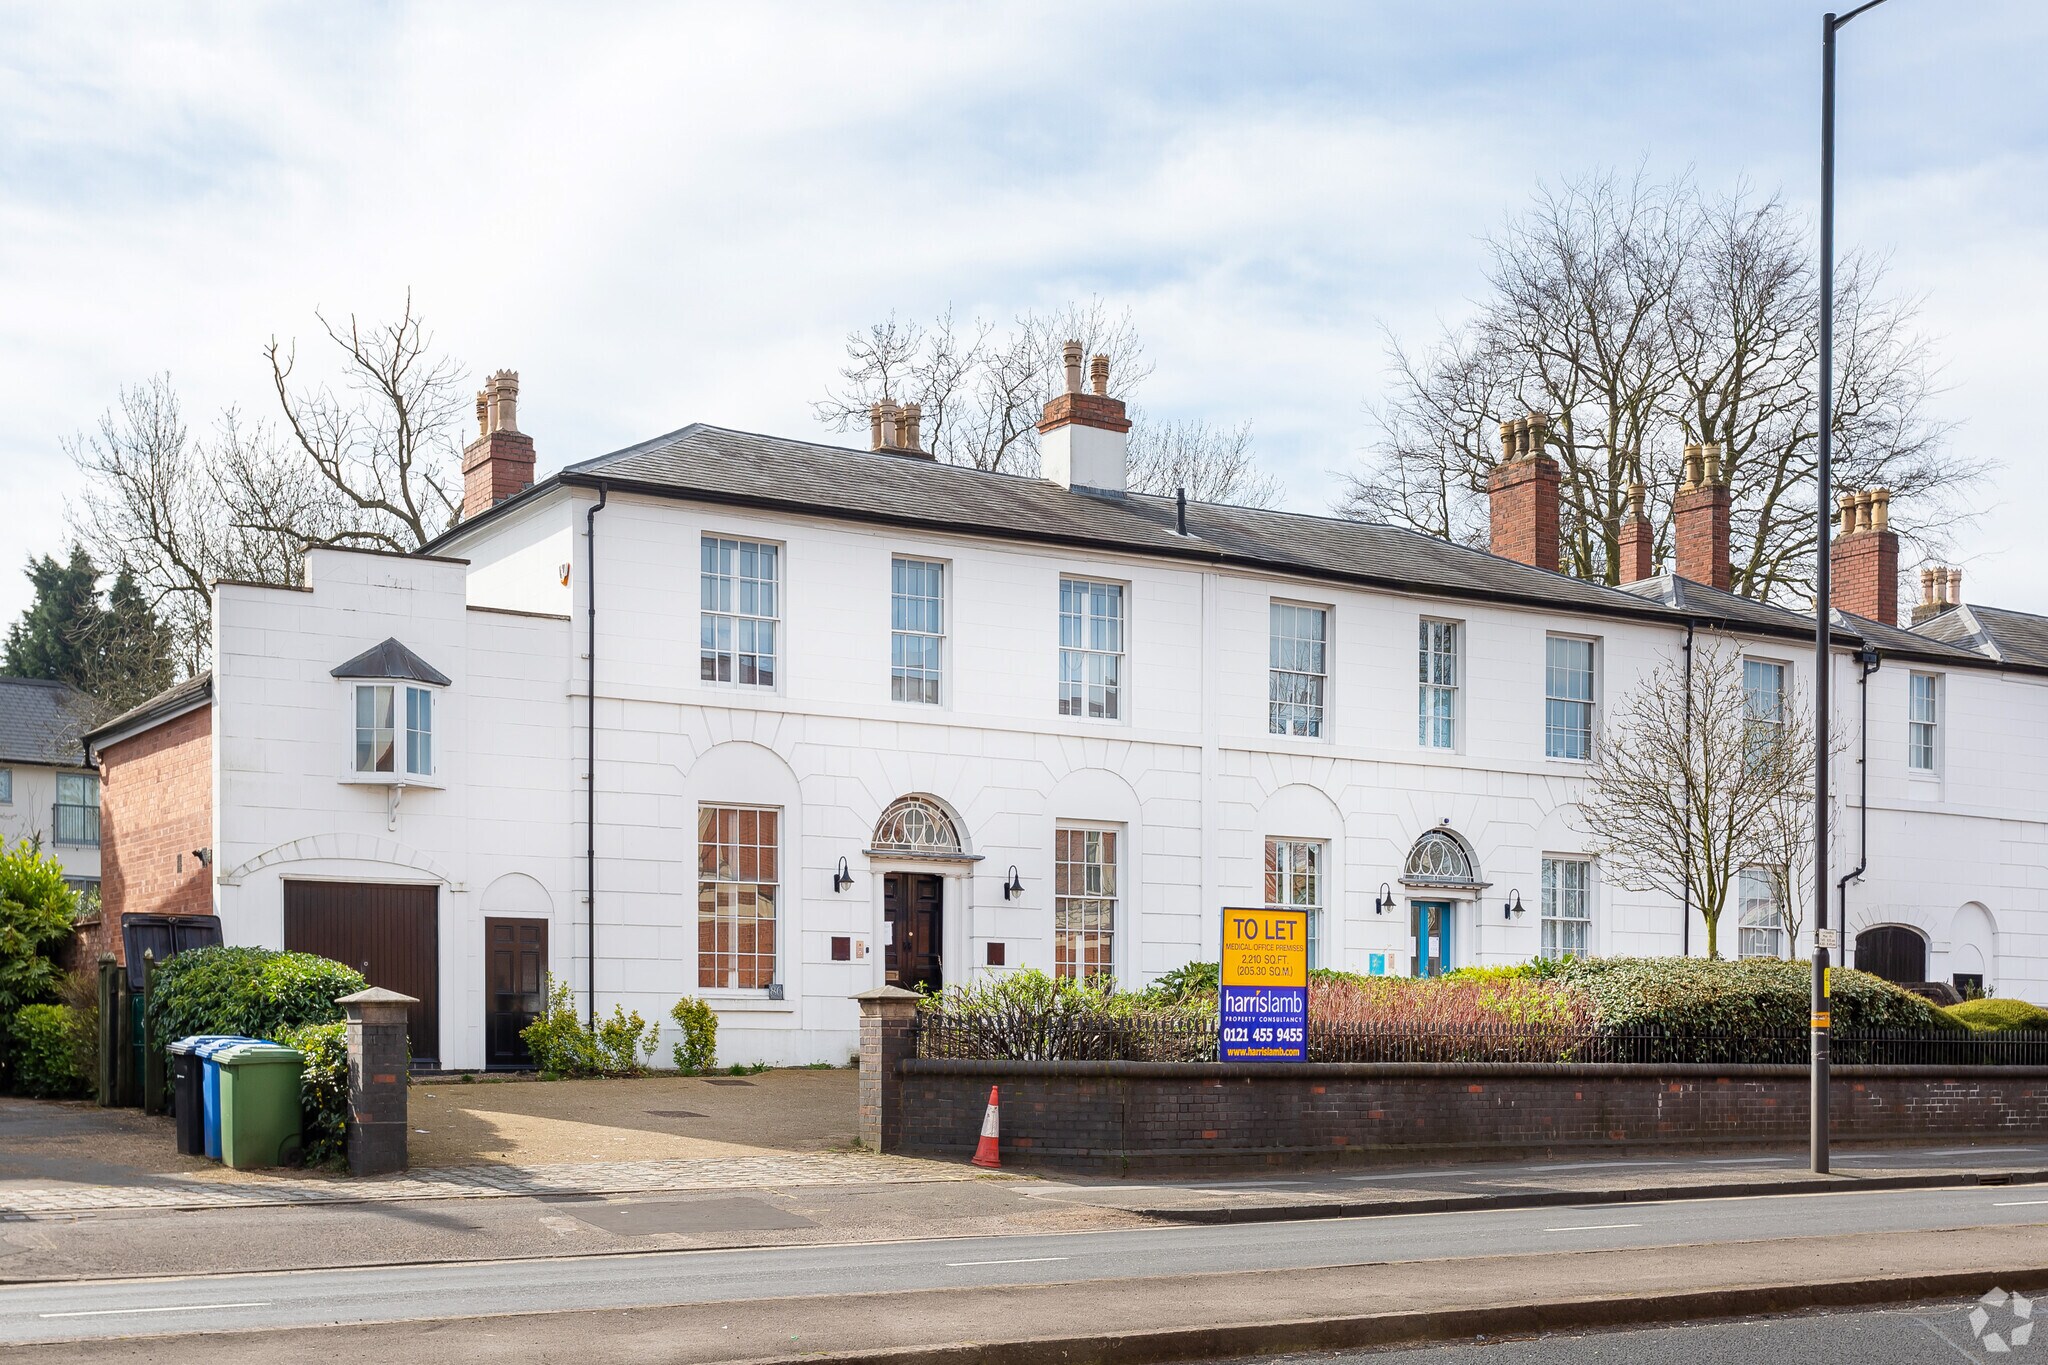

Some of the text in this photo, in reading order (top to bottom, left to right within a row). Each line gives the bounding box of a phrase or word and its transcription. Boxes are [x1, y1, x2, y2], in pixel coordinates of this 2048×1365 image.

[1233, 918, 1297, 940] TO LET
[1226, 943, 1251, 951] MEDICAL
[1253, 944, 1274, 952] OFFICE
[1241, 954, 1289, 965] 2,210 SQ.FT.
[1237, 965, 1266, 977] (205.30
[1225, 989, 1303, 1013] harrislamb
[1223, 1027, 1303, 1042] 0121 455 9455
[1227, 1046, 1300, 1057] www.harrislamb.com
